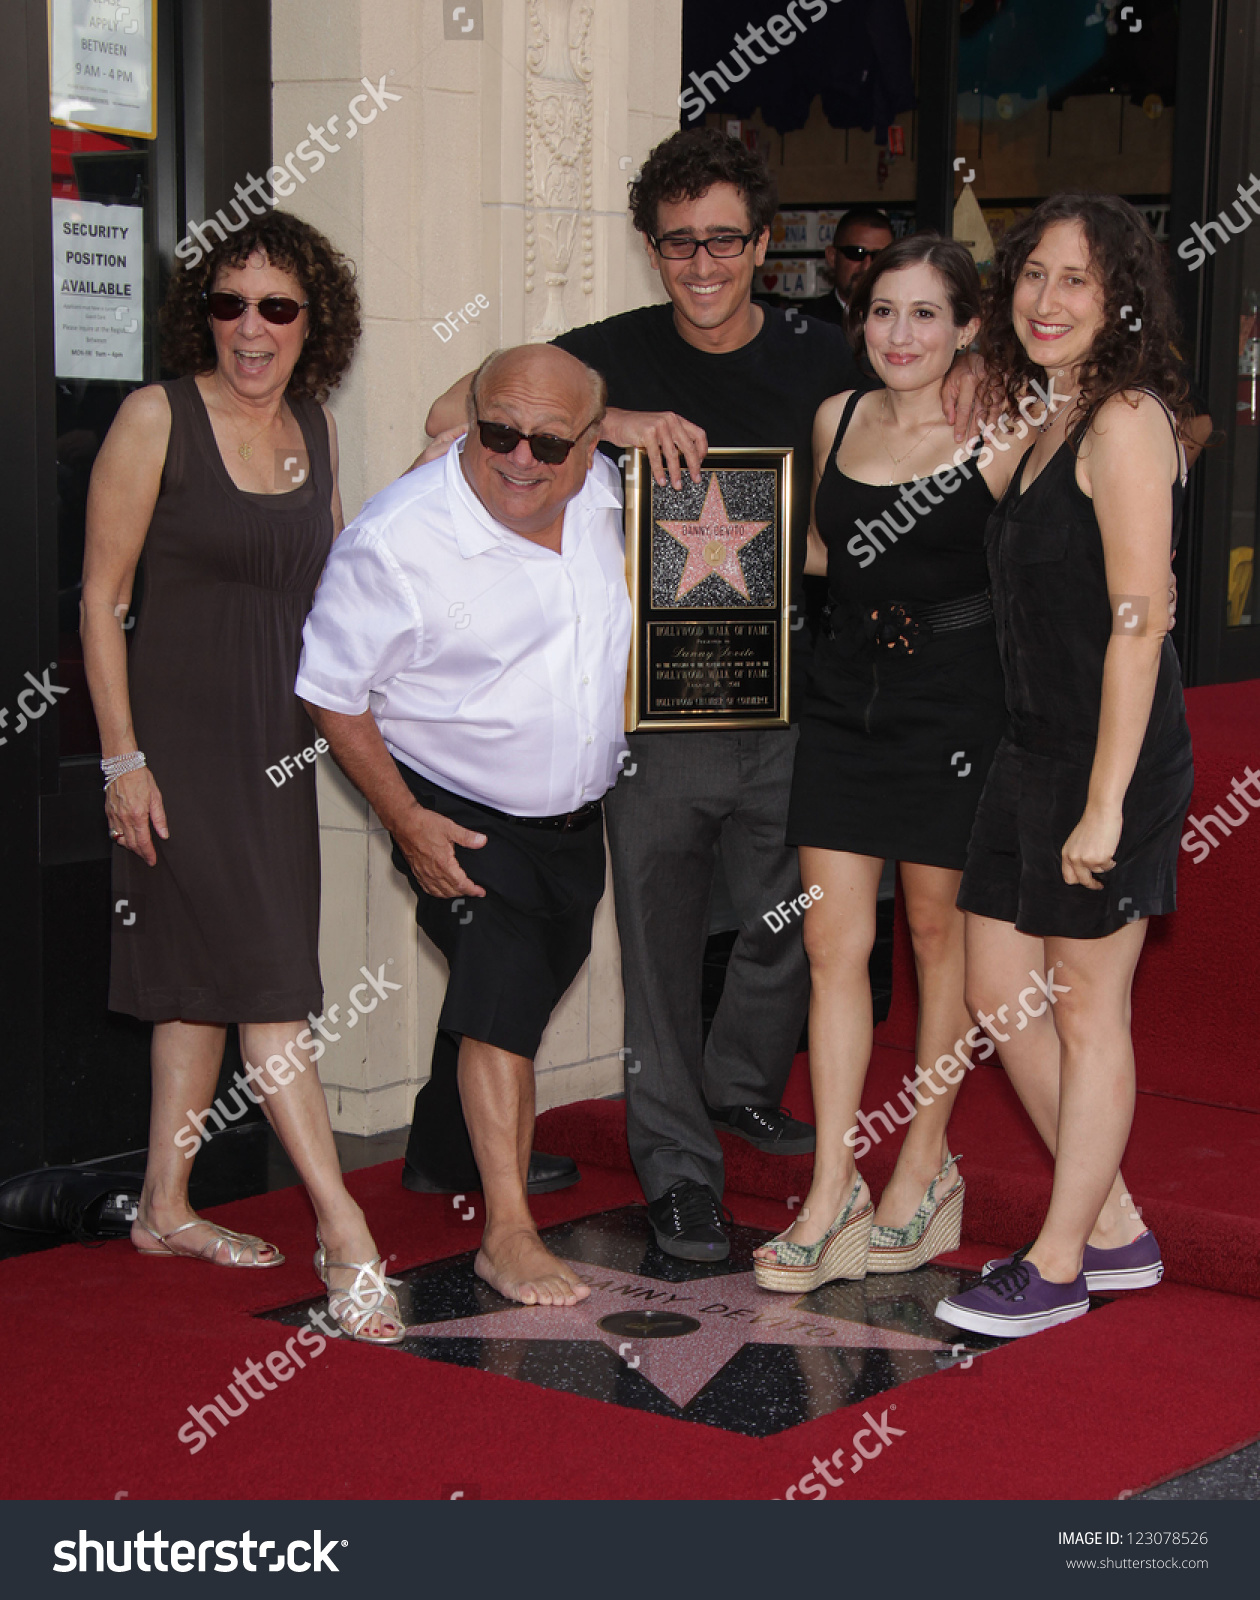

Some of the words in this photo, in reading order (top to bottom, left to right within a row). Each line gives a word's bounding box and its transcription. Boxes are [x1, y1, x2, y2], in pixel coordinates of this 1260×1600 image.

[90, 16, 119, 32] APPLY
[81, 38, 127, 57] BETWEEN
[75, 62, 82, 75] 9
[84, 64, 100, 78] AM
[108, 68, 115, 80] 4
[117, 69, 133, 83] PM
[62, 222, 129, 240] SECURITY
[65, 250, 127, 268] POSITION
[61, 279, 132, 296] AVAILABLE
[682, 524, 710, 536] DANNY
[656, 626, 704, 636] HOLLYWOOD
[748, 625, 770, 635] FAME
[656, 670, 704, 680] HOLLYWOOD
[748, 669, 770, 679] FAME
[699, 1303, 837, 1338] DEVITO
